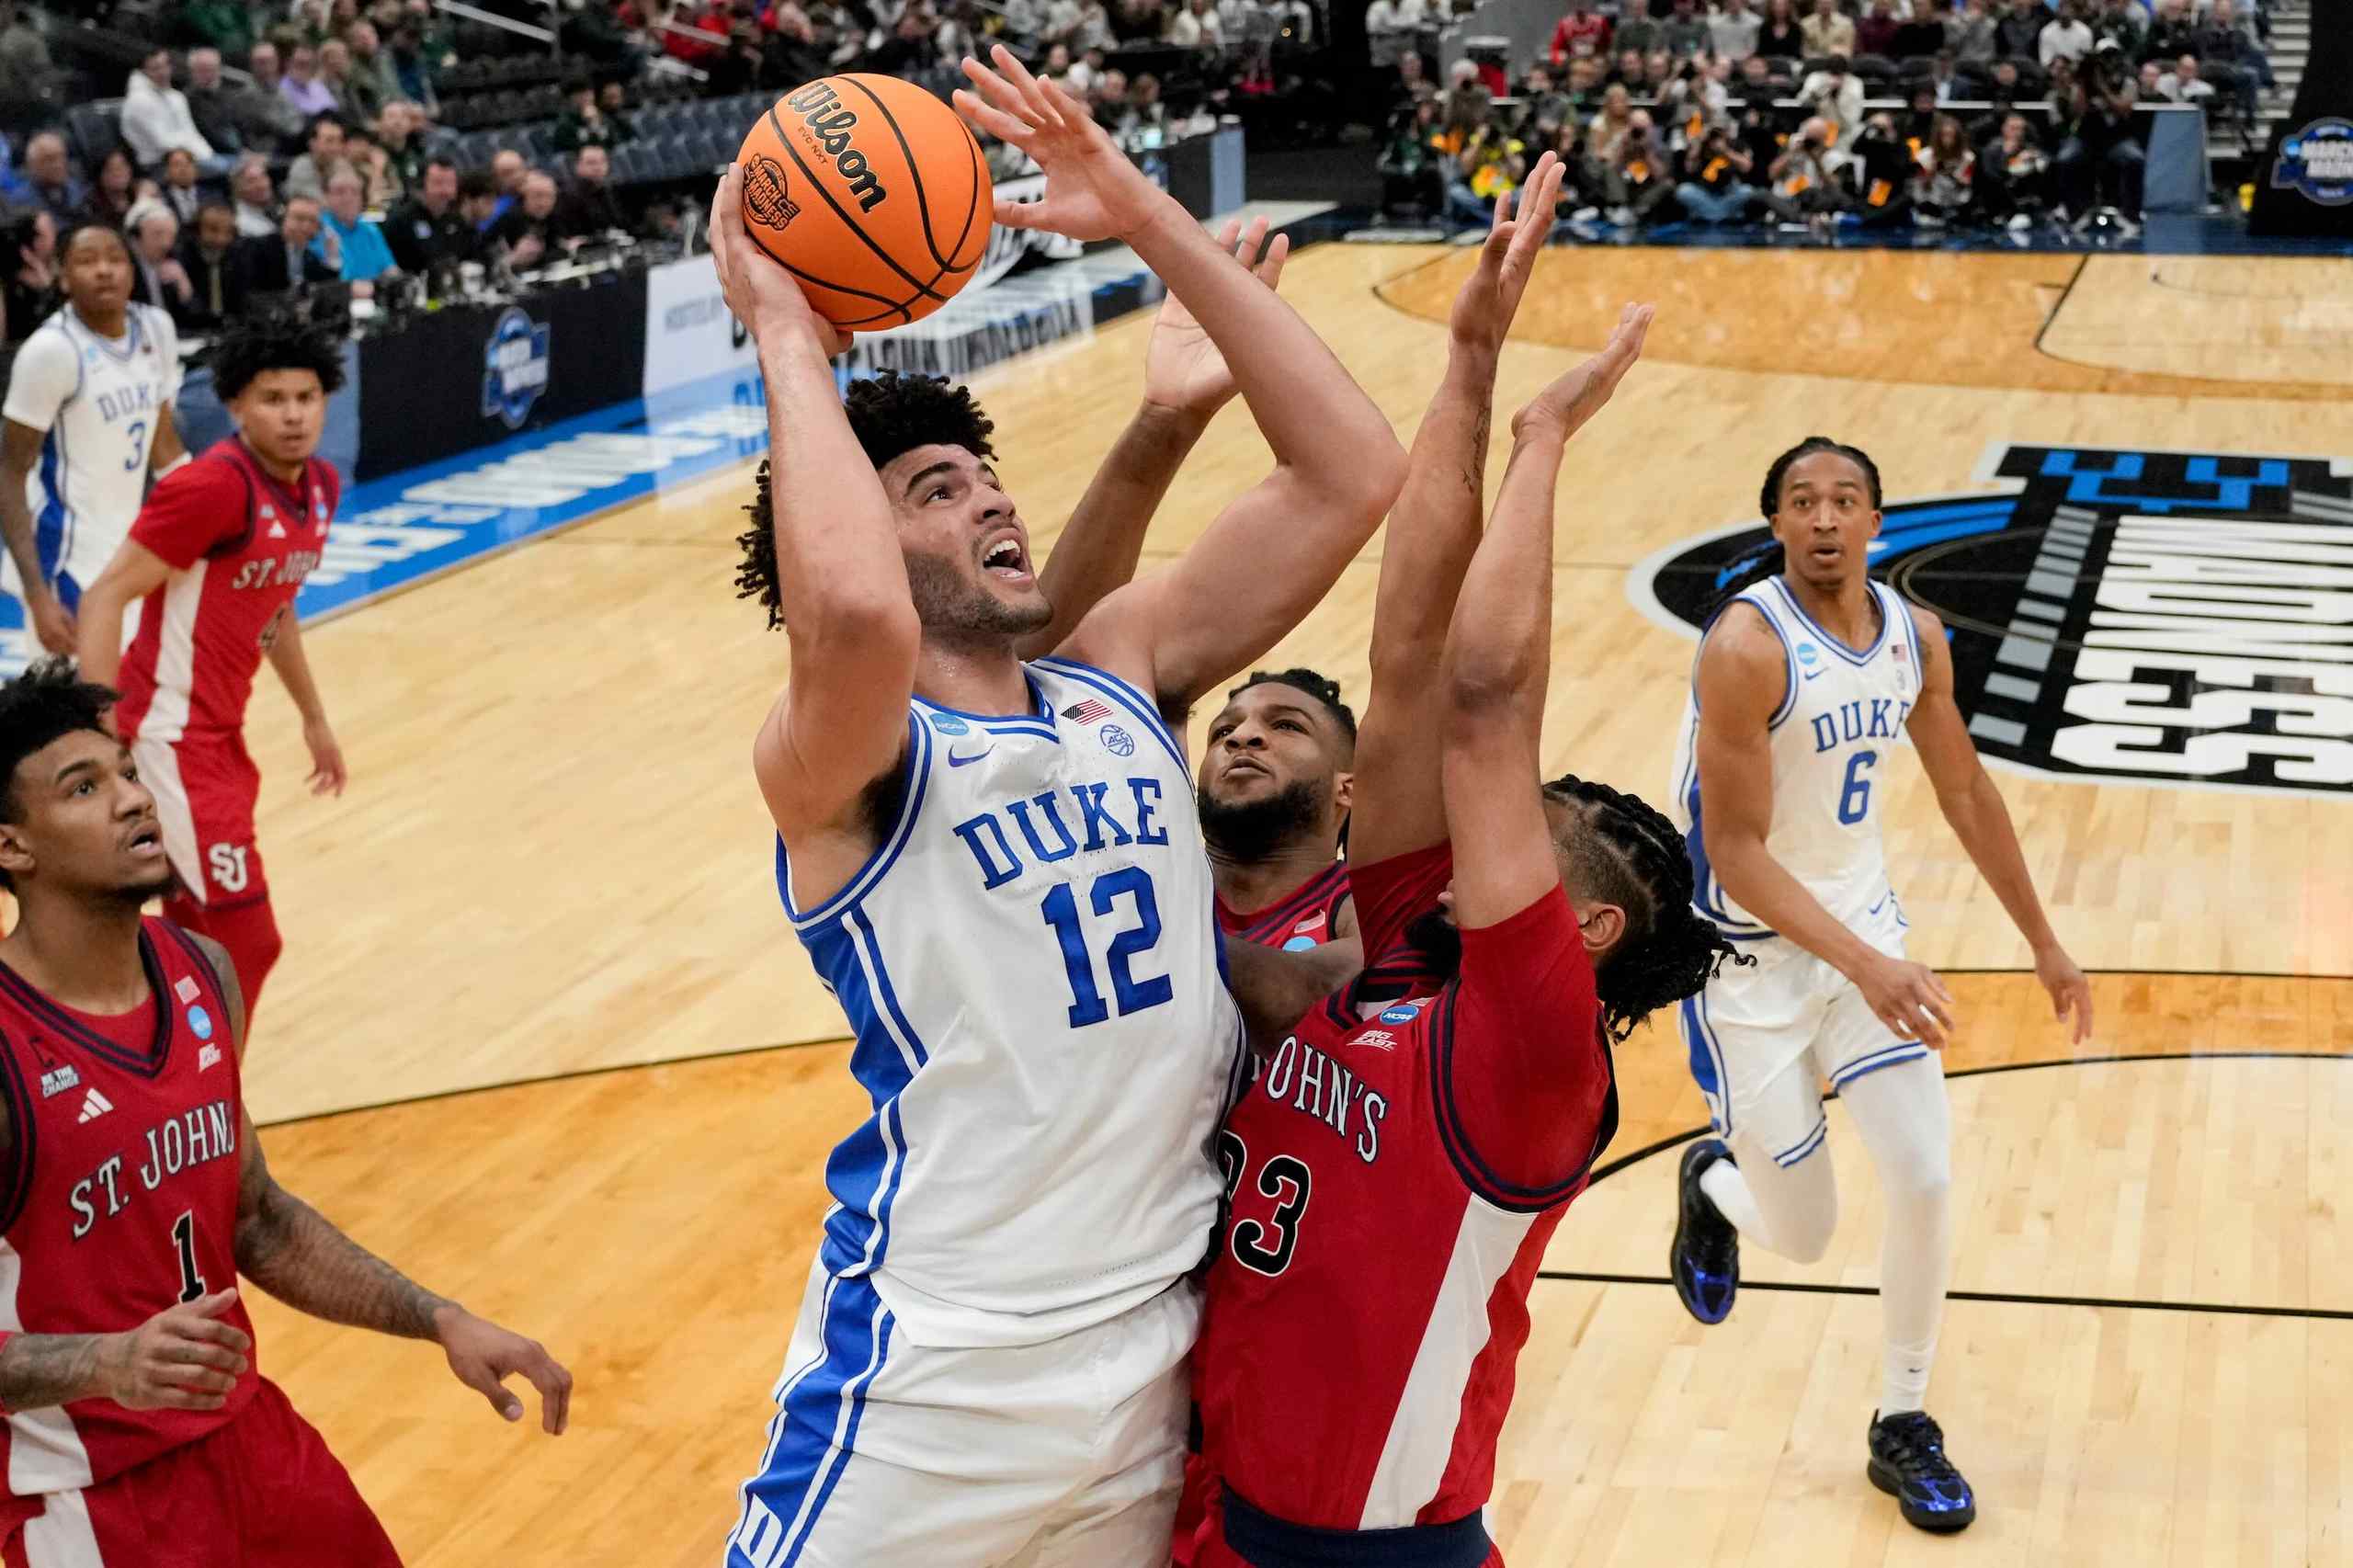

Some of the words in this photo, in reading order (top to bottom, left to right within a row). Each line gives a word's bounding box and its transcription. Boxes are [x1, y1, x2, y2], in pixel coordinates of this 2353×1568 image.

[754, 164, 781, 203] MARCH
[788, 81, 886, 214] Wilson
[798, 125, 813, 145] EVO
[811, 143, 828, 165] NXT
[748, 177, 788, 229] MADNESS
[97, 381, 156, 424] DUK
[124, 420, 146, 472] 3
[1838, 750, 1878, 825] 6
[952, 778, 1169, 891] DUKE
[1040, 866, 1174, 1028] 12
[1252, 1036, 1386, 1164] OHN'S
[70, 1155, 130, 1238] ST.
[172, 1210, 206, 1303] 1
